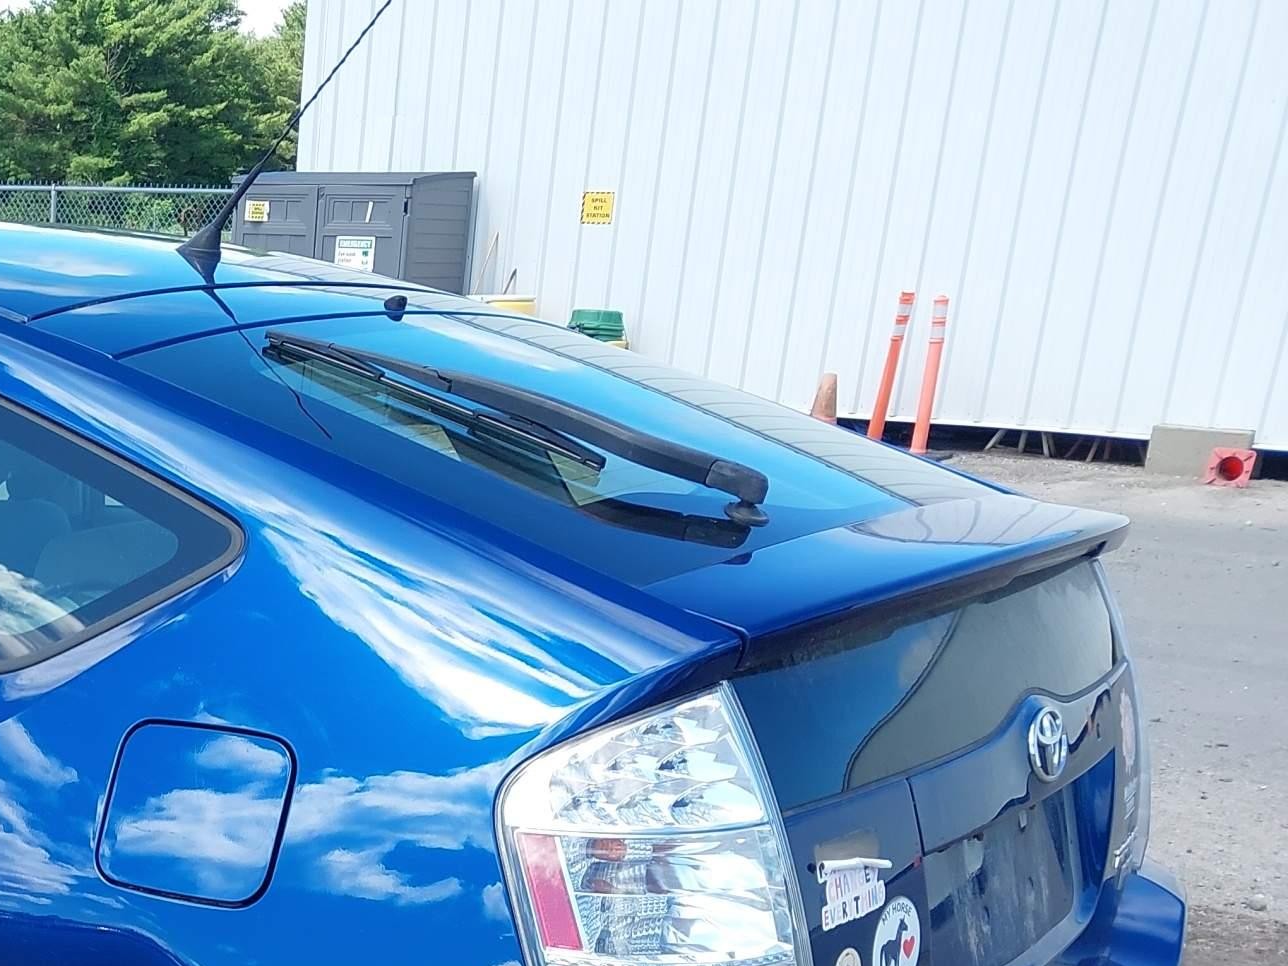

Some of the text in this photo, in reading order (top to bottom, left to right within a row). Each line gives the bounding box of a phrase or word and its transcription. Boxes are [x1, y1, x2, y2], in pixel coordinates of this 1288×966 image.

[823, 884, 885, 928] EVERYTHING
[881, 902, 912, 927] MY HORSE
